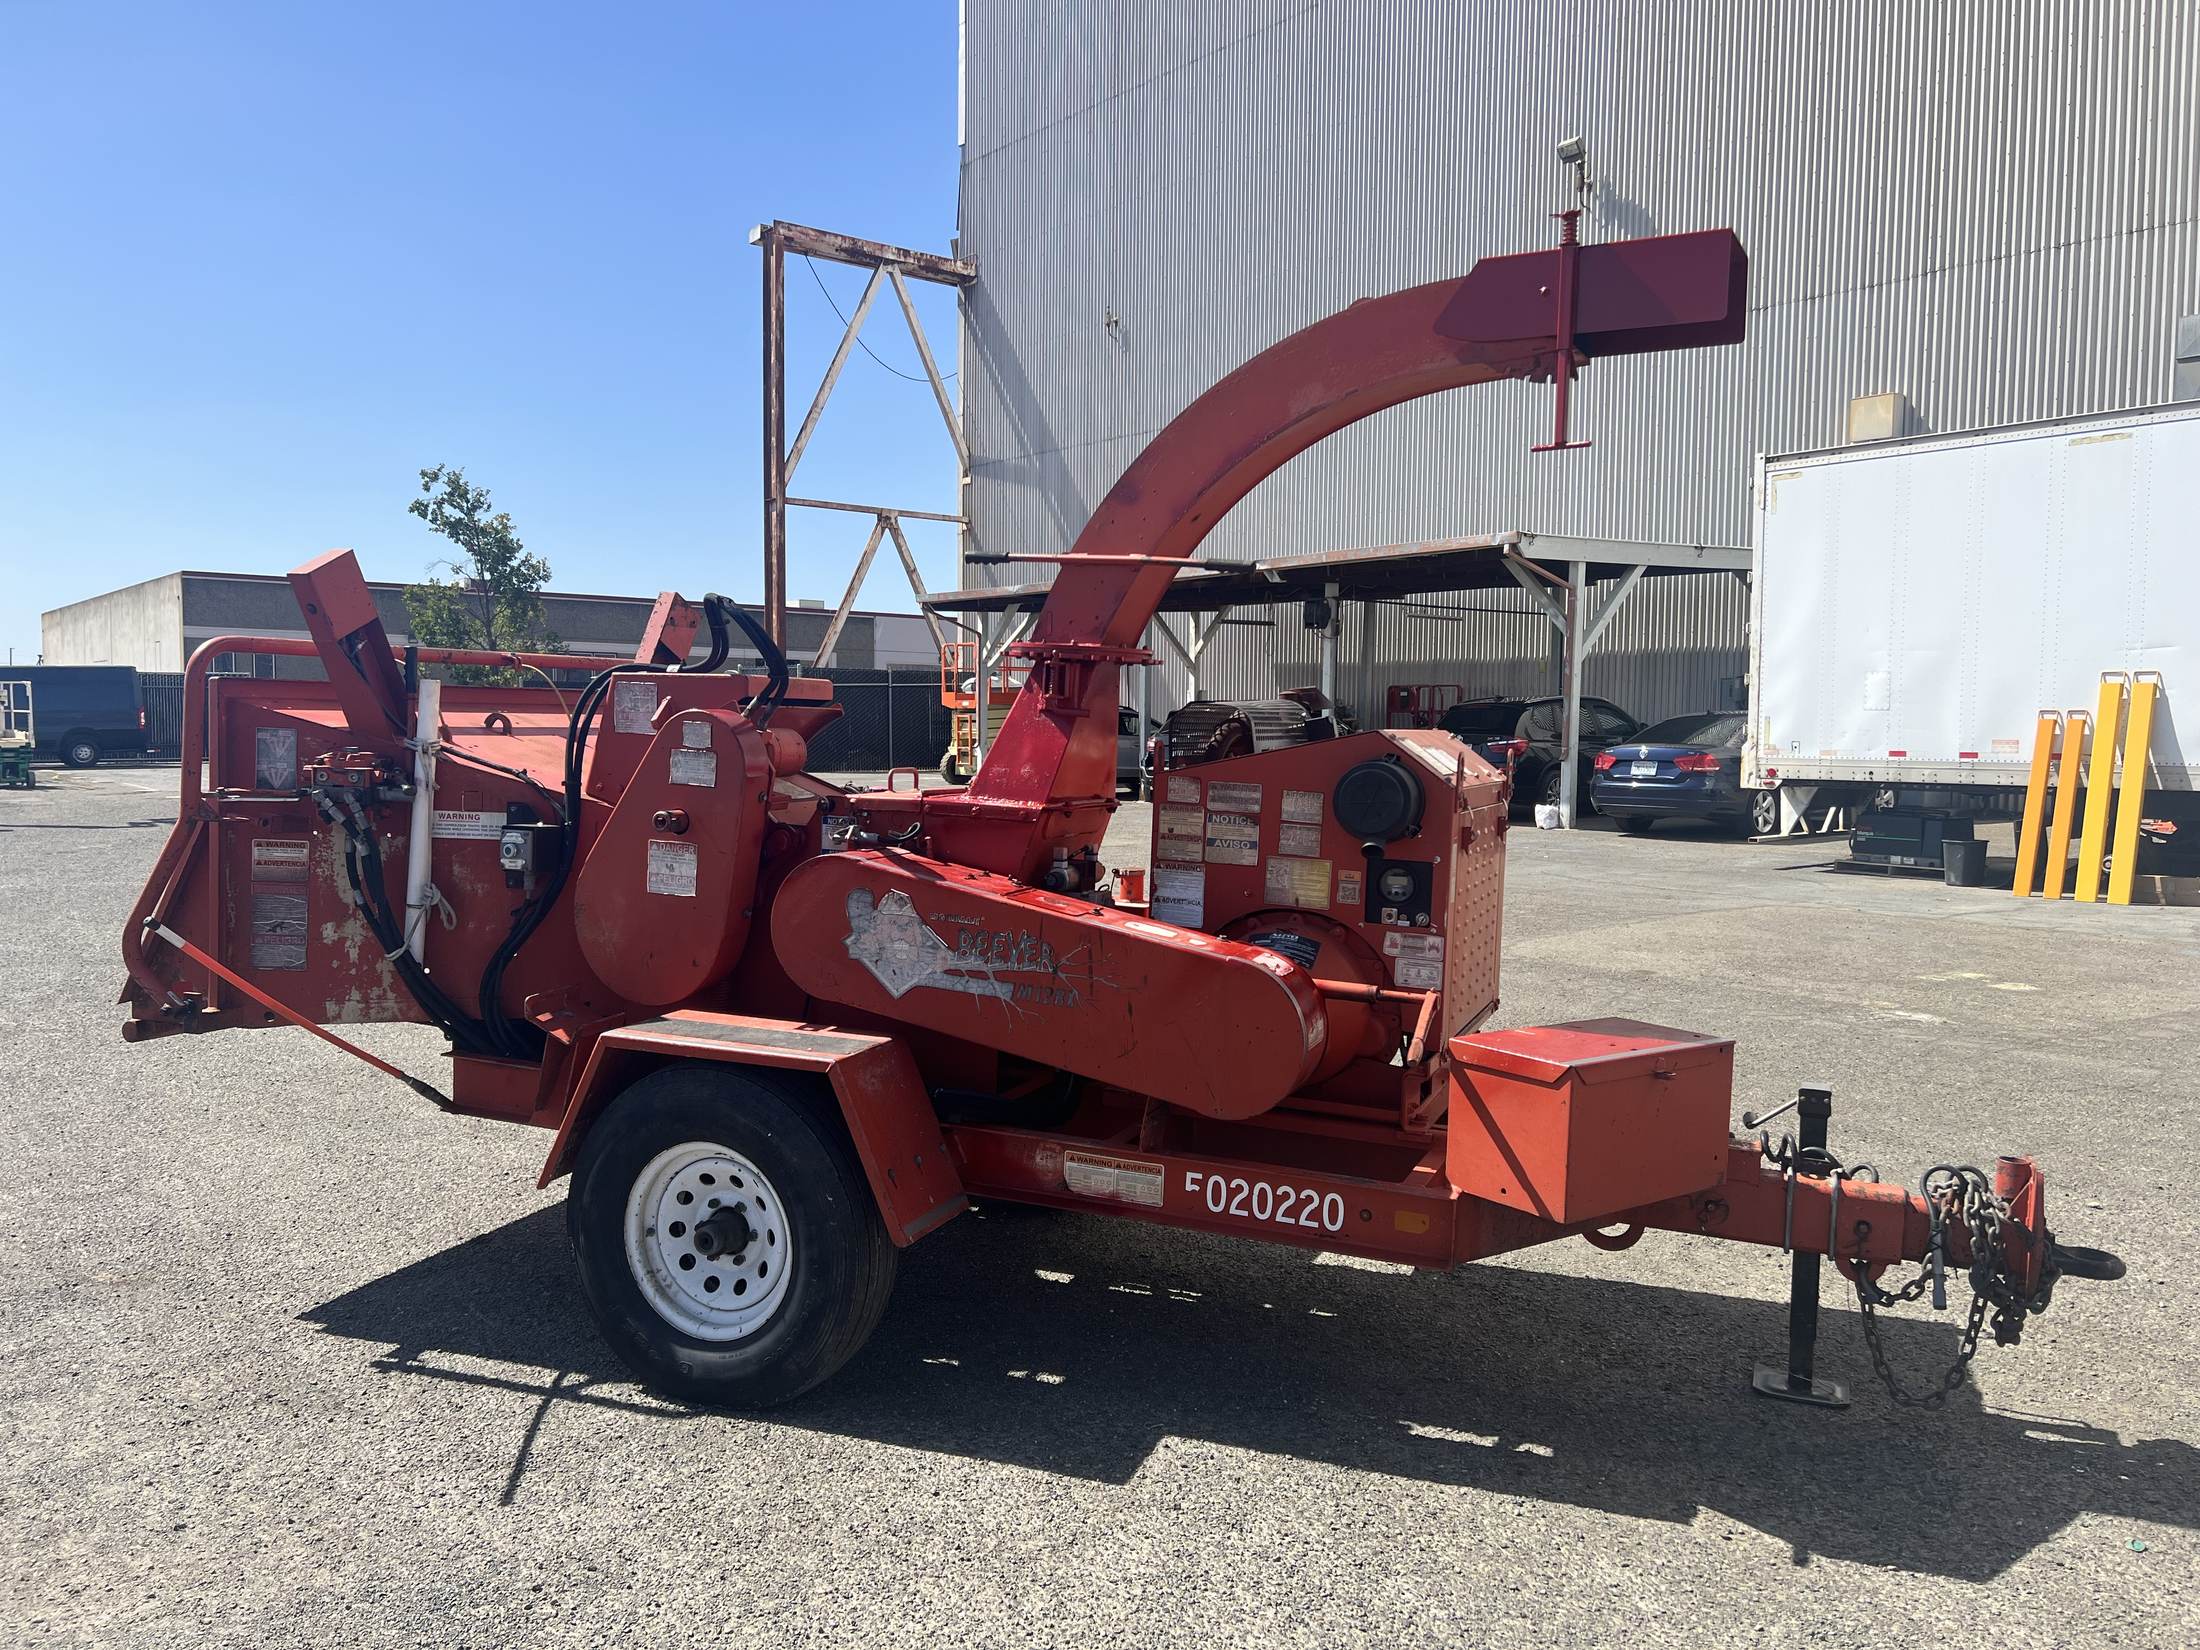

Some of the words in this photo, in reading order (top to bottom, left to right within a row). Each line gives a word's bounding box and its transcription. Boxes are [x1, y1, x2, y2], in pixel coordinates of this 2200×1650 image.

[438, 812, 481, 821] WARNING
[266, 841, 306, 849] WARNING
[659, 843, 695, 855] DANGER
[1214, 839, 1250, 849] AVISO
[1165, 863, 1202, 873] WARNING
[1076, 1155, 1113, 1168] WARNING
[1123, 1163, 1161, 1175] ADVERTENCIA
